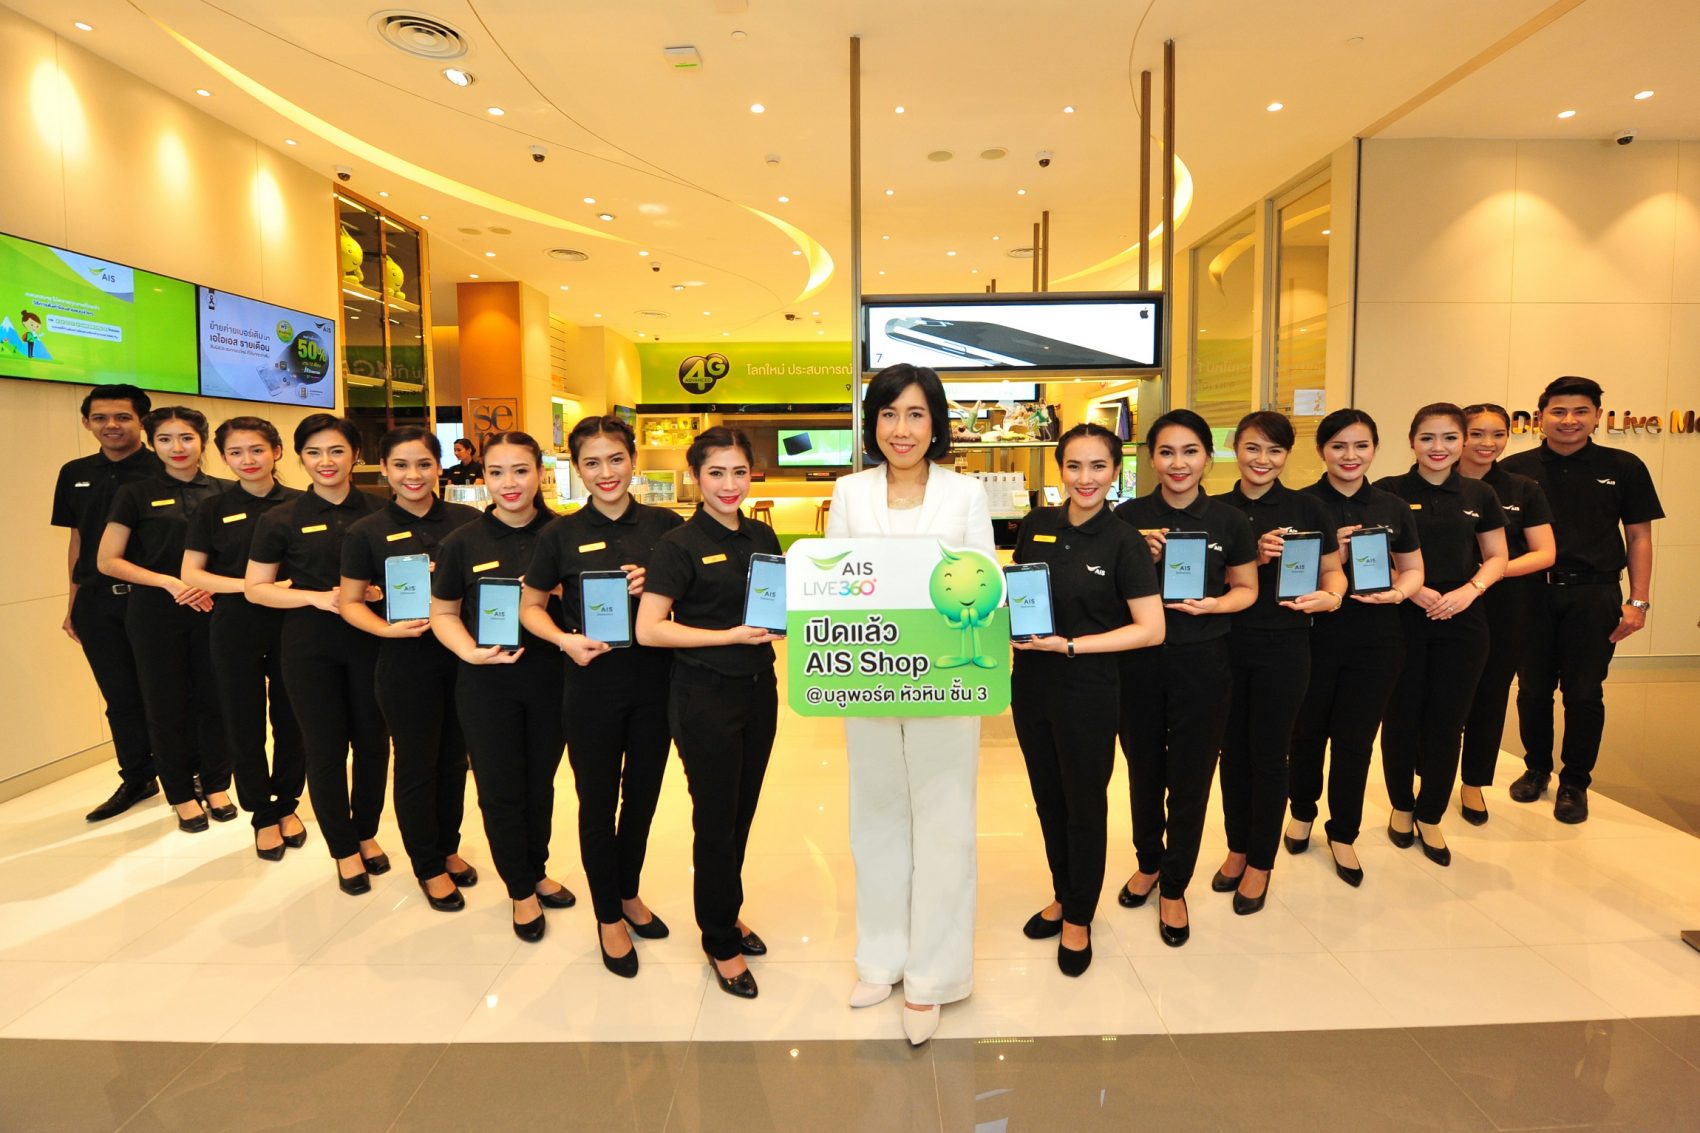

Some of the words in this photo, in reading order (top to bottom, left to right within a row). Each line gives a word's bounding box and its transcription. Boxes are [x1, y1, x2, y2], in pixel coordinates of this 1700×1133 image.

[102, 273, 116, 283] AIS
[298, 338, 327, 362] 50%
[875, 353, 883, 363] 7
[683, 357, 726, 391] 4G
[746, 363, 785, 376] โลกใหม่
[1607, 410, 1663, 434] Live
[842, 562, 874, 576] AIS
[805, 616, 898, 643] เปิดแล้ว
[806, 651, 852, 674] AIS
[860, 651, 929, 678] Shop
[806, 685, 895, 708] @บลูพอร์ต
[900, 685, 945, 701] หัวหิน
[950, 678, 972, 701] ชั้น
[977, 686, 987, 701] 3
